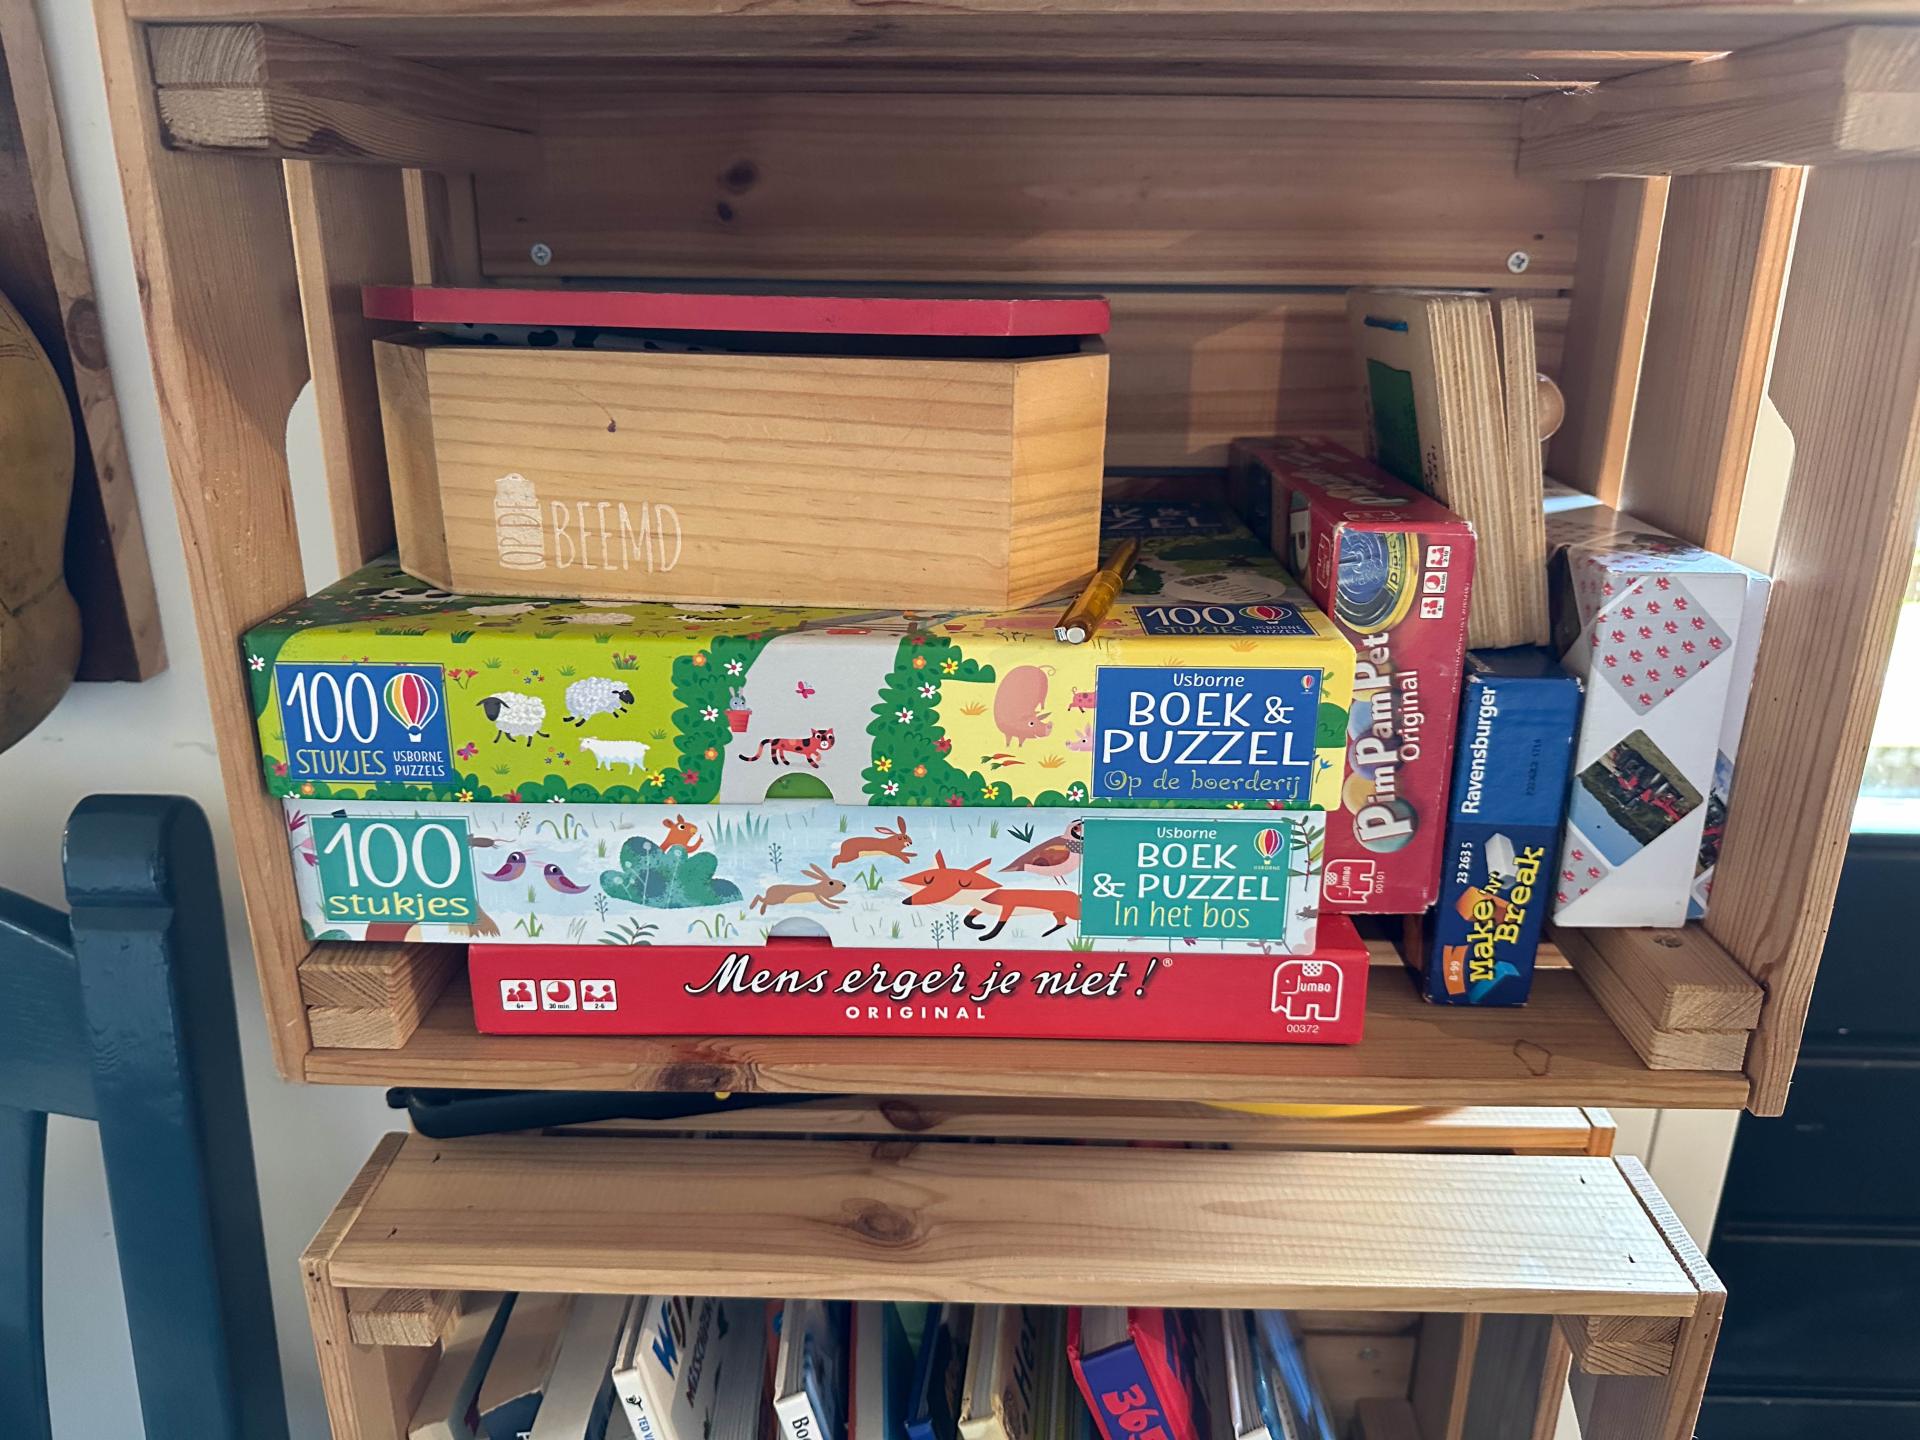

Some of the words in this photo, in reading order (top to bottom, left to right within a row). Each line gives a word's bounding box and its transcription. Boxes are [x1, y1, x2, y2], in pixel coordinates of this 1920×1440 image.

[551, 500, 682, 573] BEEMD
[1146, 606, 1235, 626] 100
[1154, 625, 1247, 634] STUKJES
[1173, 672, 1245, 688] Usborne
[286, 671, 379, 744] 100
[1129, 691, 1253, 727] BOEK
[1263, 695, 1295, 724] &
[1397, 669, 1425, 763] Original
[393, 750, 444, 763] USBORNE
[1102, 729, 1310, 766] PUZZEL
[1461, 686, 1498, 814] Ravensburger
[296, 749, 387, 776] STUKJES
[395, 764, 446, 777] PUZZELS
[1104, 769, 1143, 796] Op
[1153, 769, 1180, 790] de
[1191, 769, 1301, 799] boerderij
[1157, 826, 1217, 839] Usborne
[324, 822, 461, 889] 100
[1137, 842, 1238, 869] BOEK
[1459, 851, 1472, 869] 263
[1092, 873, 1126, 898] &
[1138, 873, 1280, 901] PUZZEL
[1375, 871, 1385, 894] 00101
[1456, 871, 1468, 884] 23
[328, 891, 470, 921] stukjes
[1493, 846, 1545, 945] Break
[1115, 900, 1139, 927] In
[1150, 900, 1193, 928] het
[1203, 901, 1250, 929] bos
[1467, 899, 1496, 982] Make
[684, 952, 829, 994] Mens
[833, 961, 967, 1001] erger
[969, 960, 1021, 1002] je
[845, 1006, 986, 1019] ORIGINAL
[1286, 1024, 1320, 1033] 00372
[637, 1415, 651, 1432] TED
[792, 1415, 812, 1440] Bo
